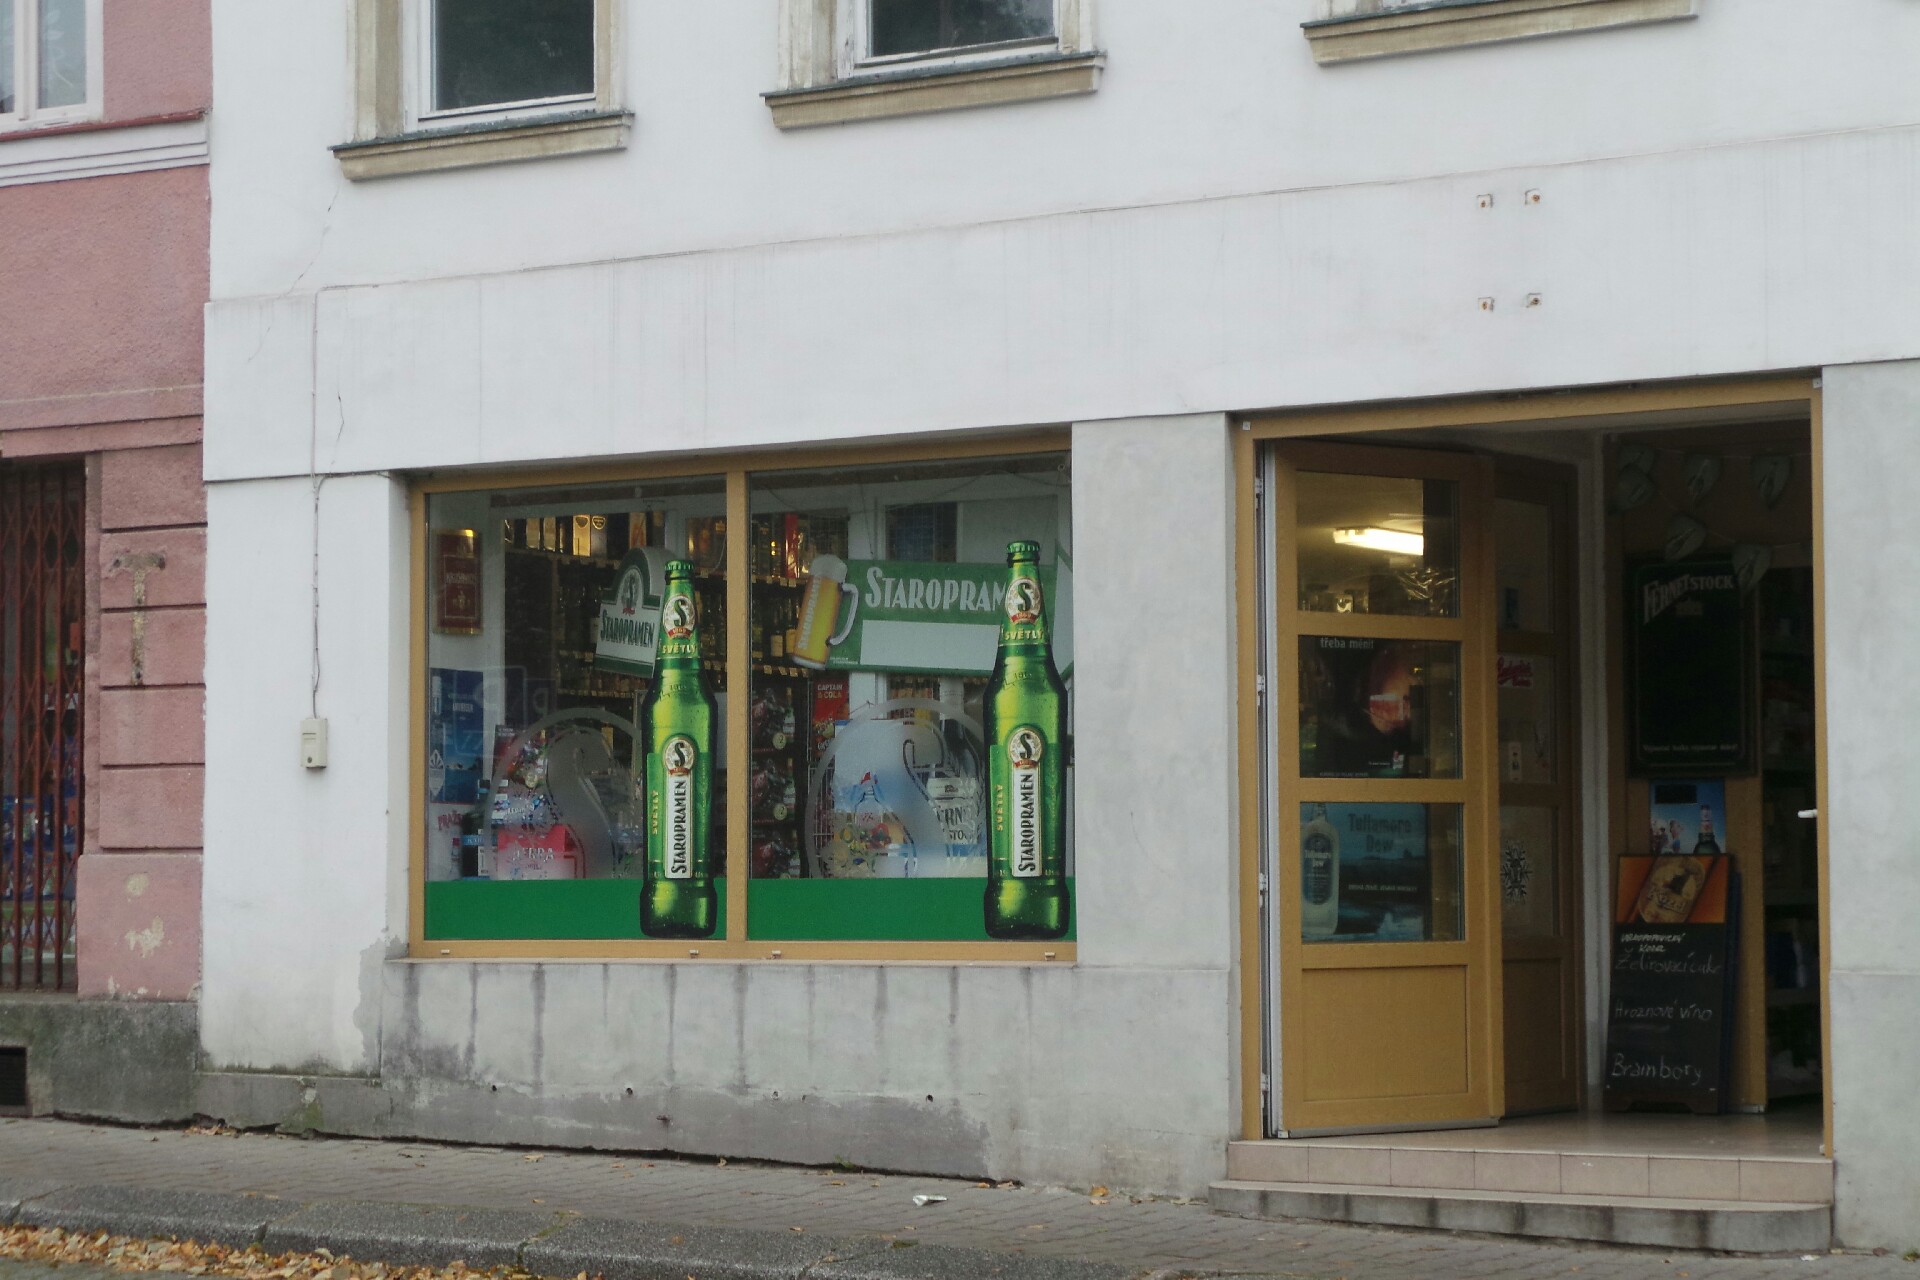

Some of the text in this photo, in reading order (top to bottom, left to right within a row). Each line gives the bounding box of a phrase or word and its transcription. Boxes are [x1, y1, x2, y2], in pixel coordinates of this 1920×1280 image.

[865, 566, 1006, 612] STAROPRAM
[600, 609, 655, 648] STAROPRAMEN
[1320, 637, 1346, 649] třeba
[670, 781, 688, 874] STAROPRAMEN
[1018, 774, 1036, 872] STAROPRAMEN
[1680, 1003, 1714, 1021] víno
[1611, 1052, 1702, 1086] Brambory
